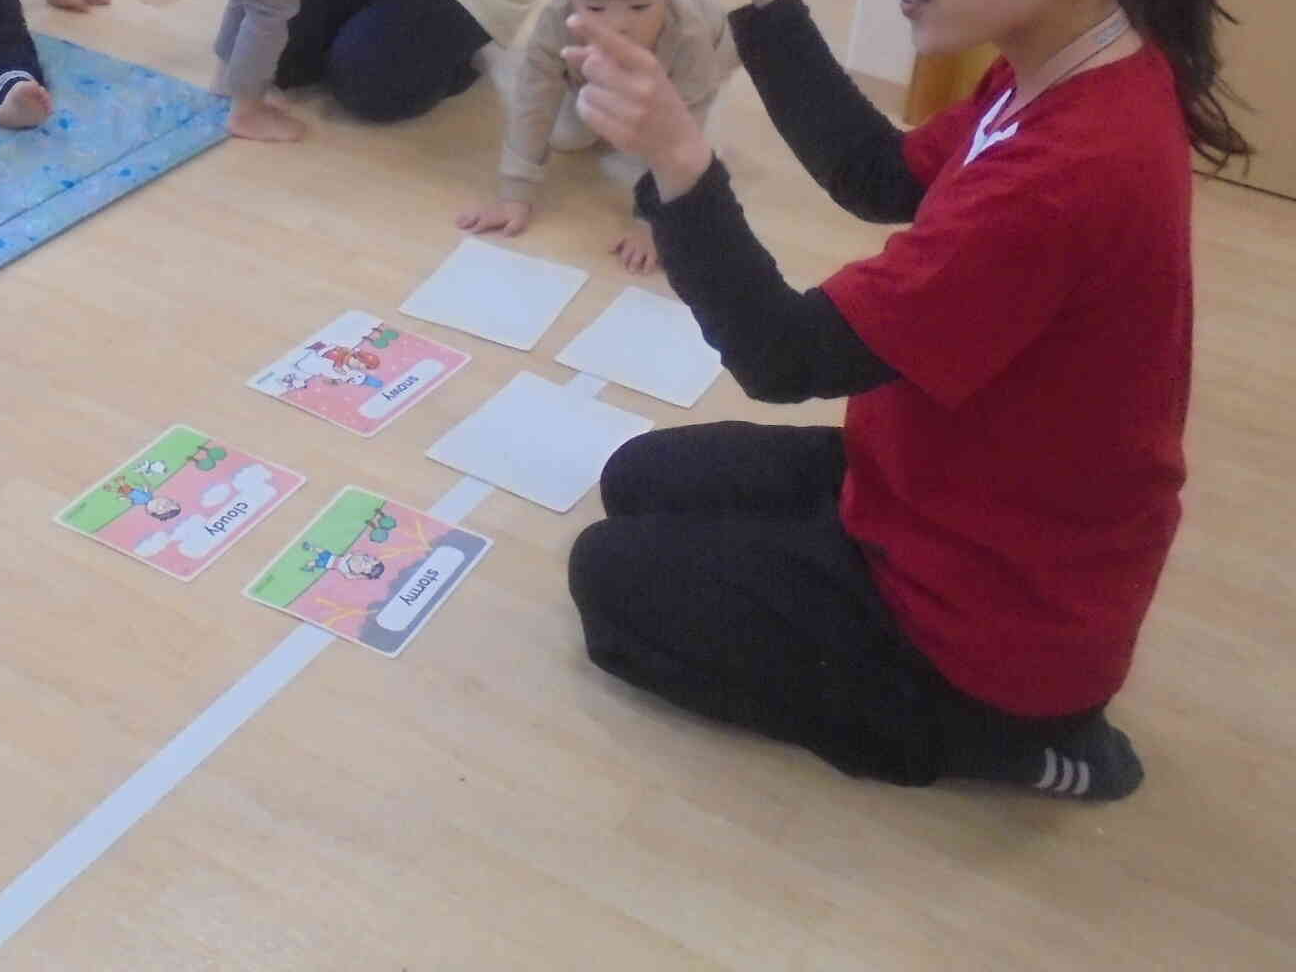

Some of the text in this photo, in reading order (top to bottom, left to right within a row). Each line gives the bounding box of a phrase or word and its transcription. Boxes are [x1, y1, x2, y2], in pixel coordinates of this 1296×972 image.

[382, 375, 419, 401] snowy
[204, 502, 249, 536] cloudy
[399, 568, 439, 606] stormy
